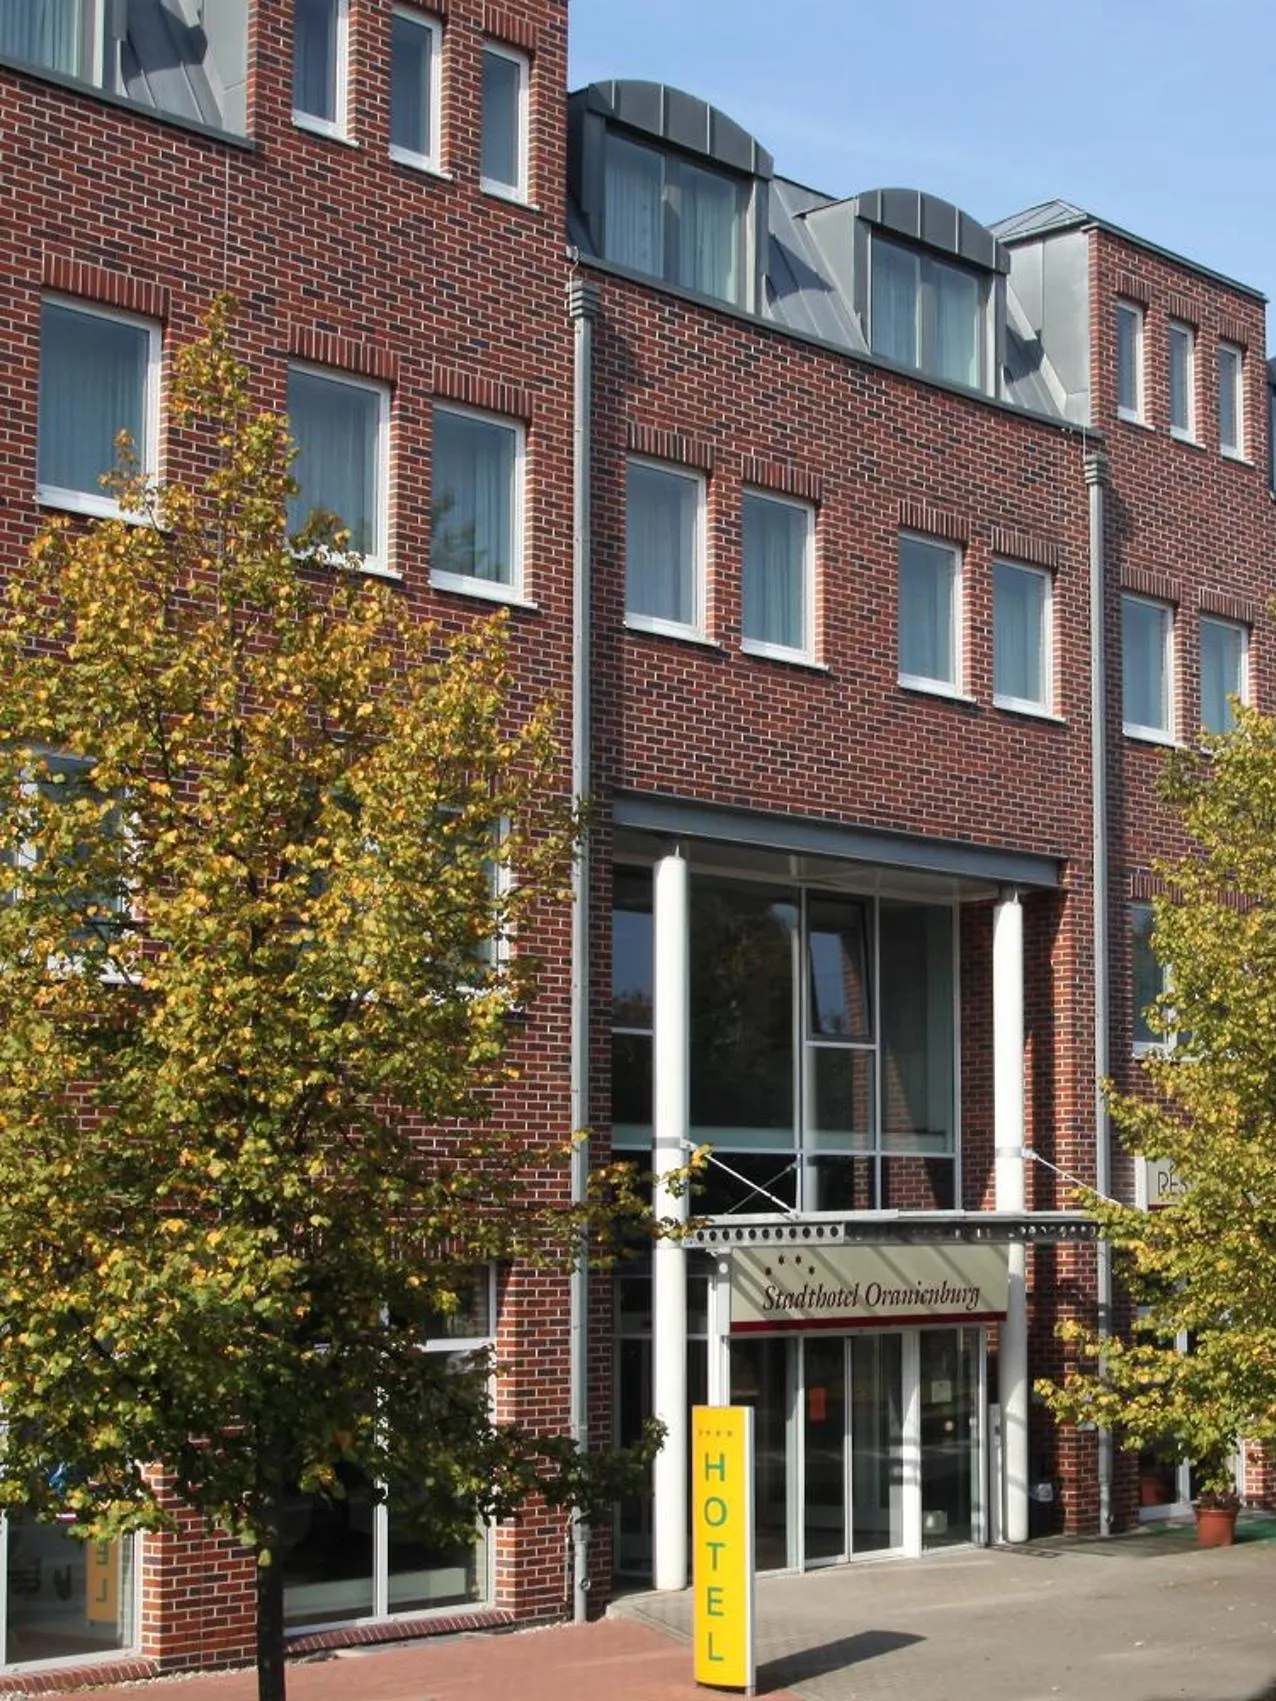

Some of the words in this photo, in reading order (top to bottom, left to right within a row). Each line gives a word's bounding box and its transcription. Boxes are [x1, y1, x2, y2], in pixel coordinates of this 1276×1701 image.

[762, 1283, 860, 1311] Stadthotel
[865, 1281, 981, 1310] Oranienburg
[704, 1452, 728, 1661] HOTEL
